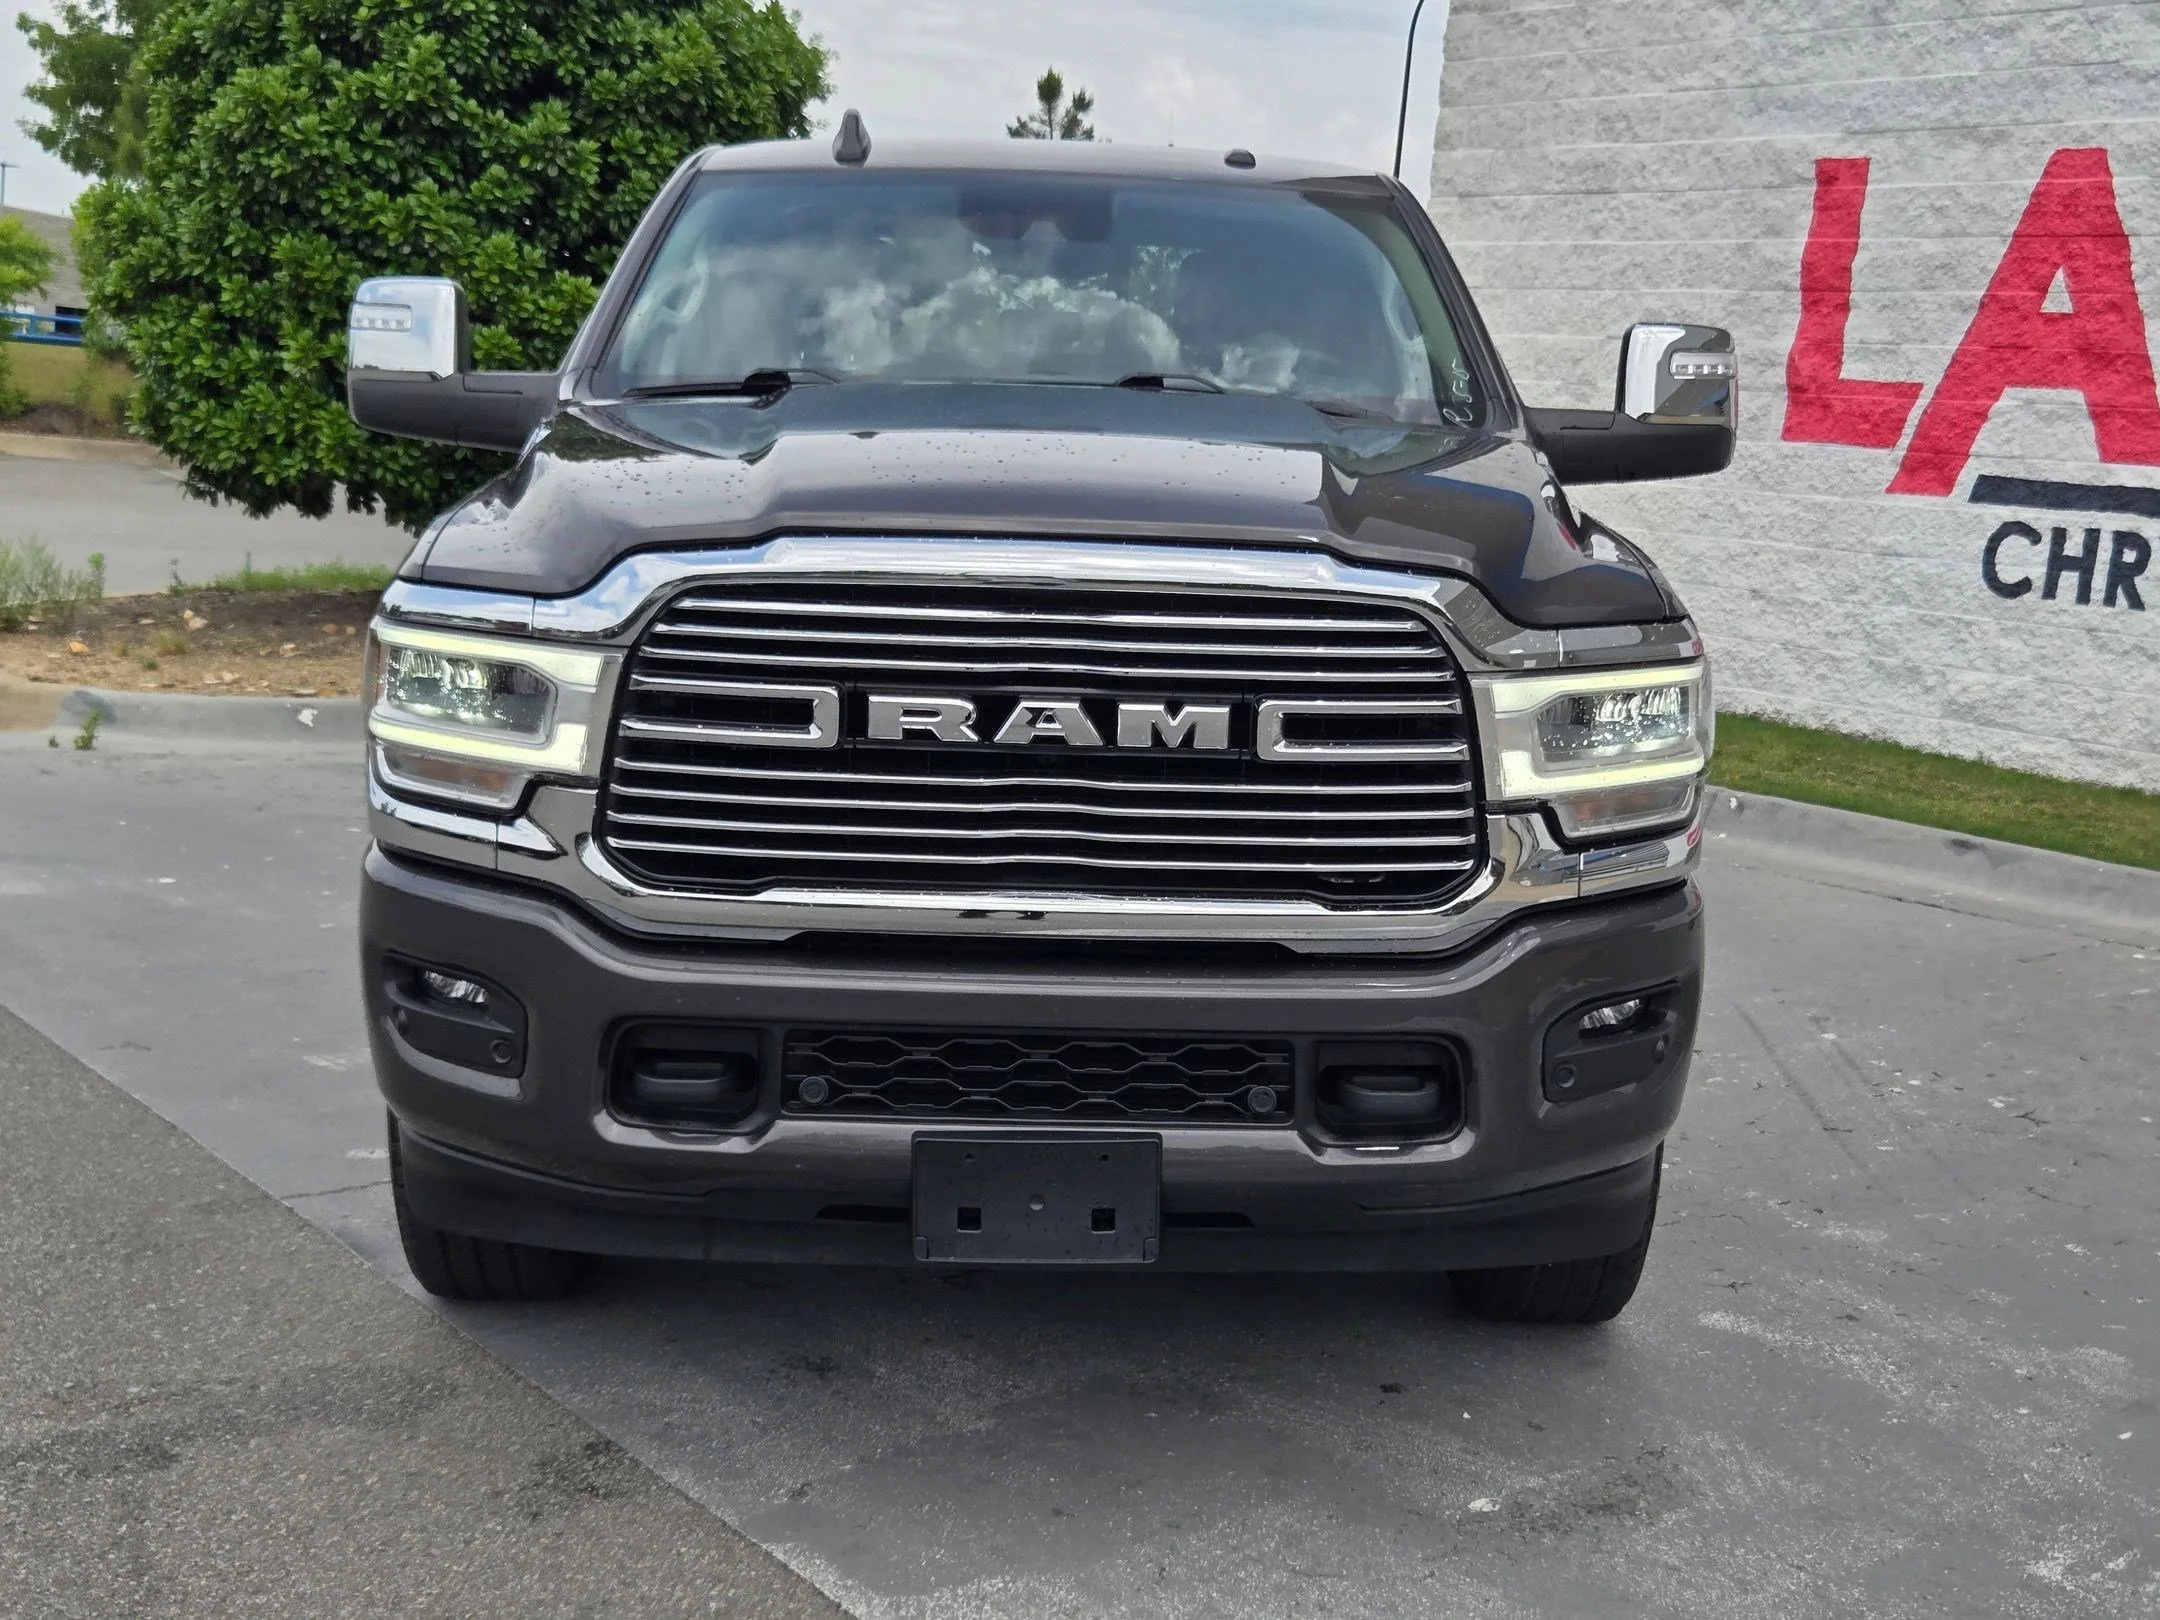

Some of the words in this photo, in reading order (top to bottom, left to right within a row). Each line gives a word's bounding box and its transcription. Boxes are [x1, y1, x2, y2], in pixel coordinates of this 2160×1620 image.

[1781, 147, 2160, 497] LA
[1981, 520, 2152, 611] CHR
[867, 694, 1231, 750] RAM
